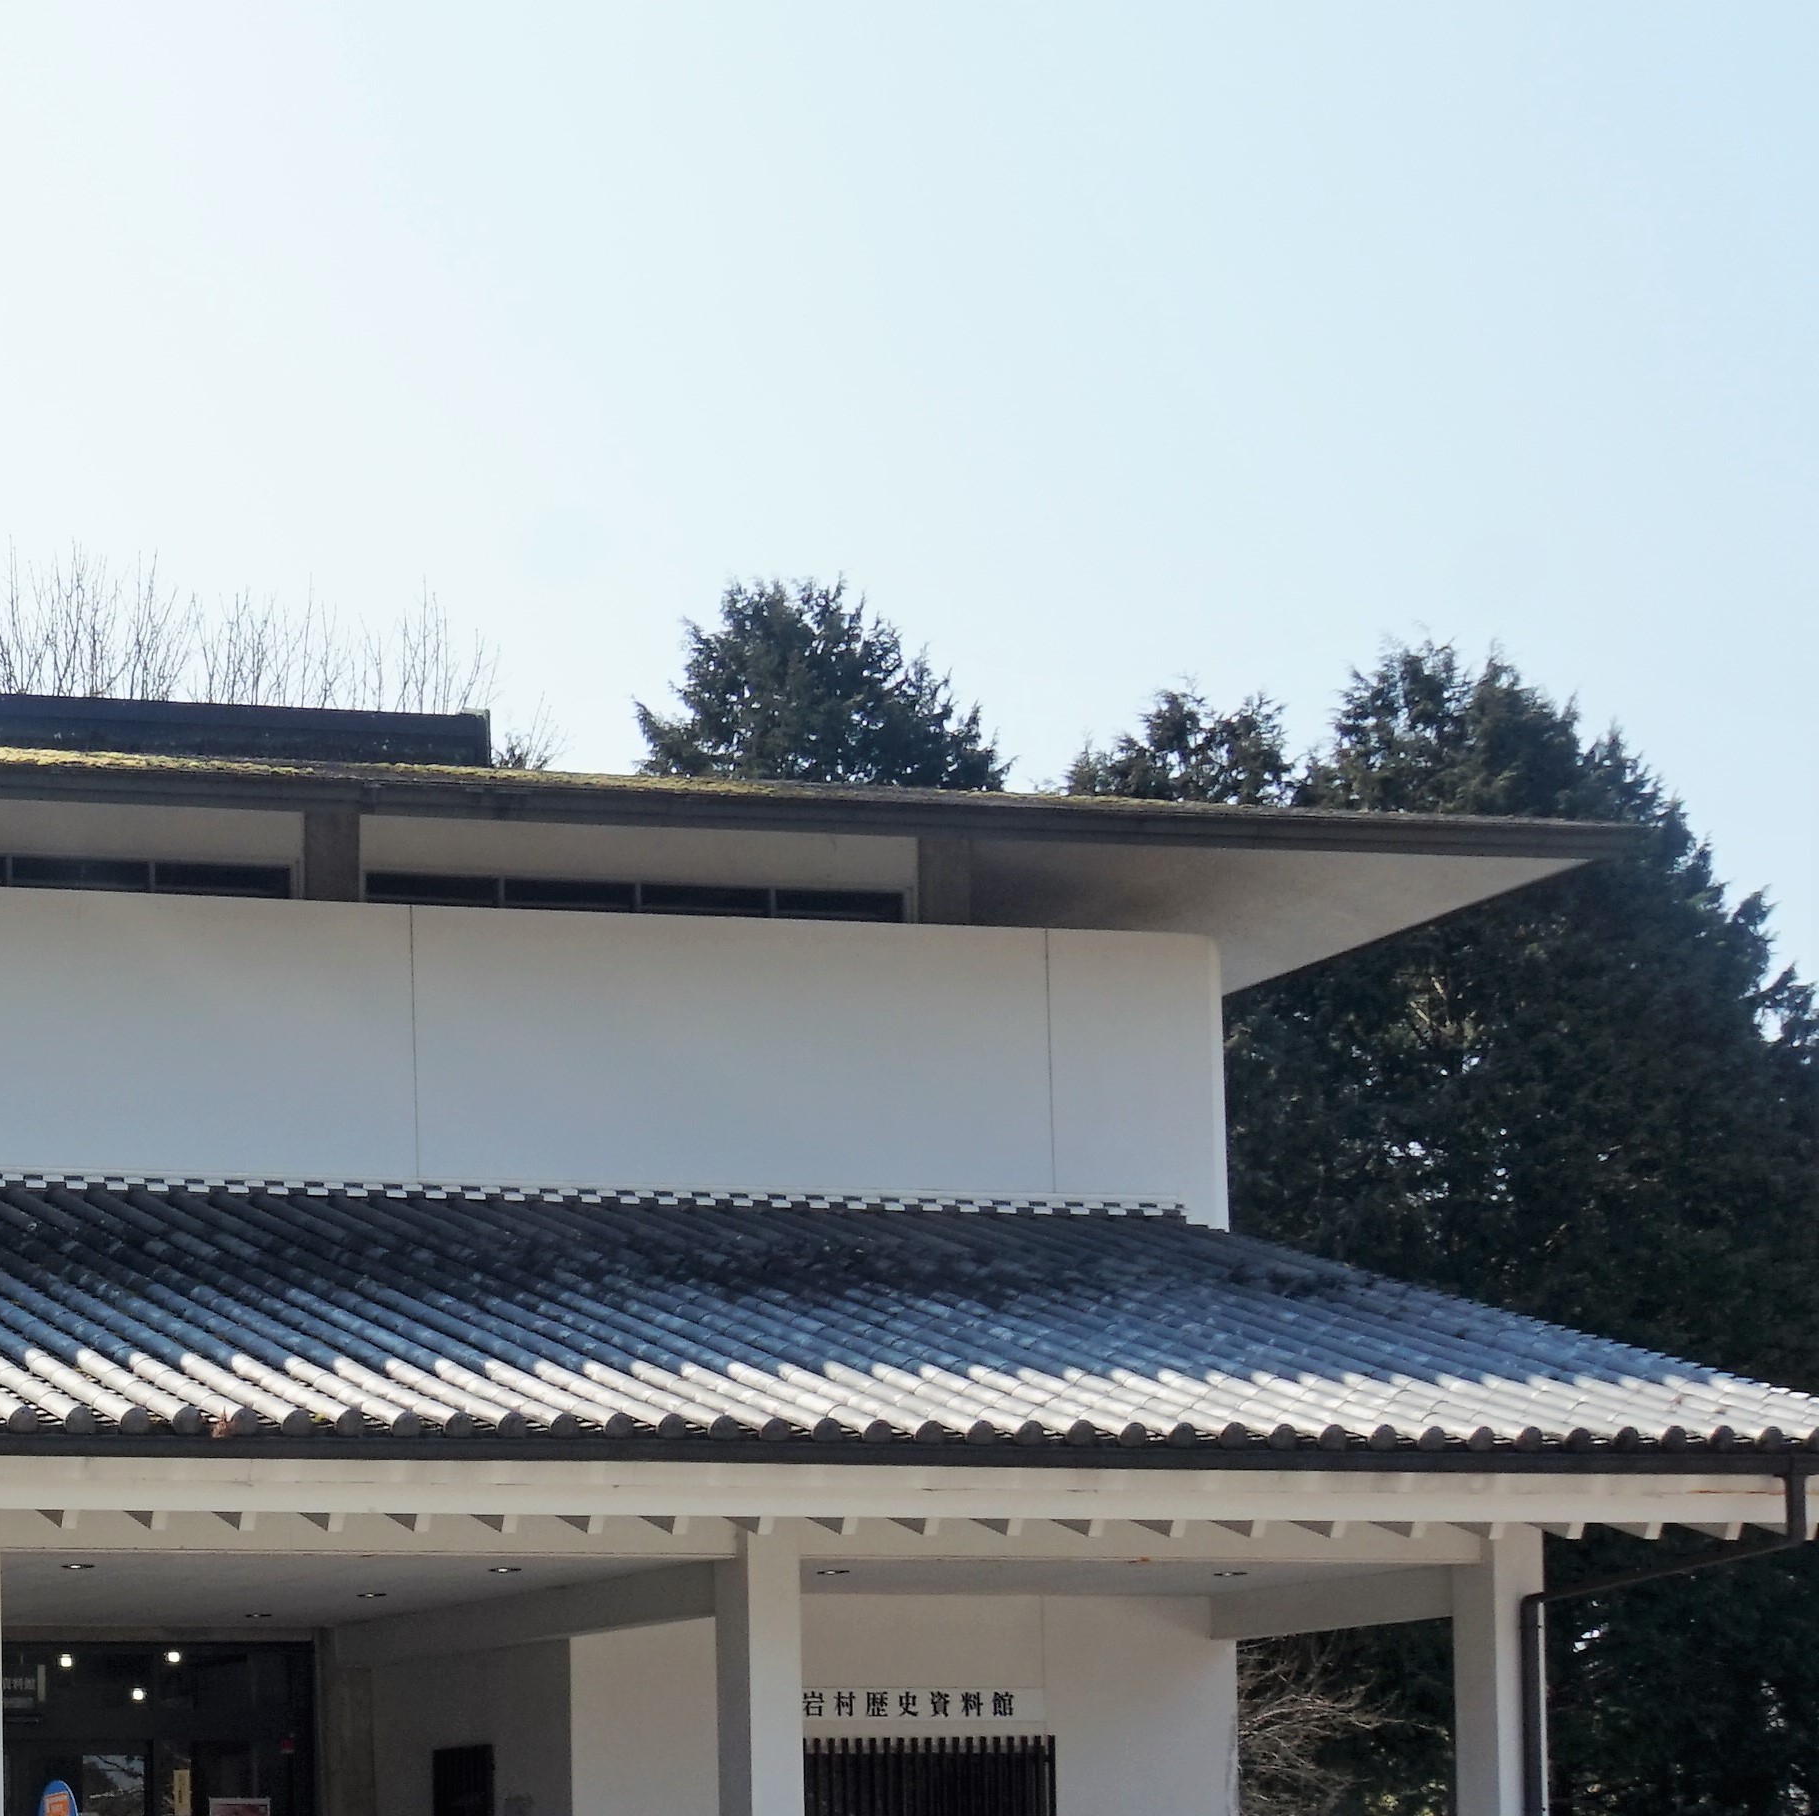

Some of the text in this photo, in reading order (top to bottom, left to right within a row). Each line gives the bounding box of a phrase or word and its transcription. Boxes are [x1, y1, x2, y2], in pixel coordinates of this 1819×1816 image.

[803, 1691, 1015, 1718] 岩村歴史資料館
